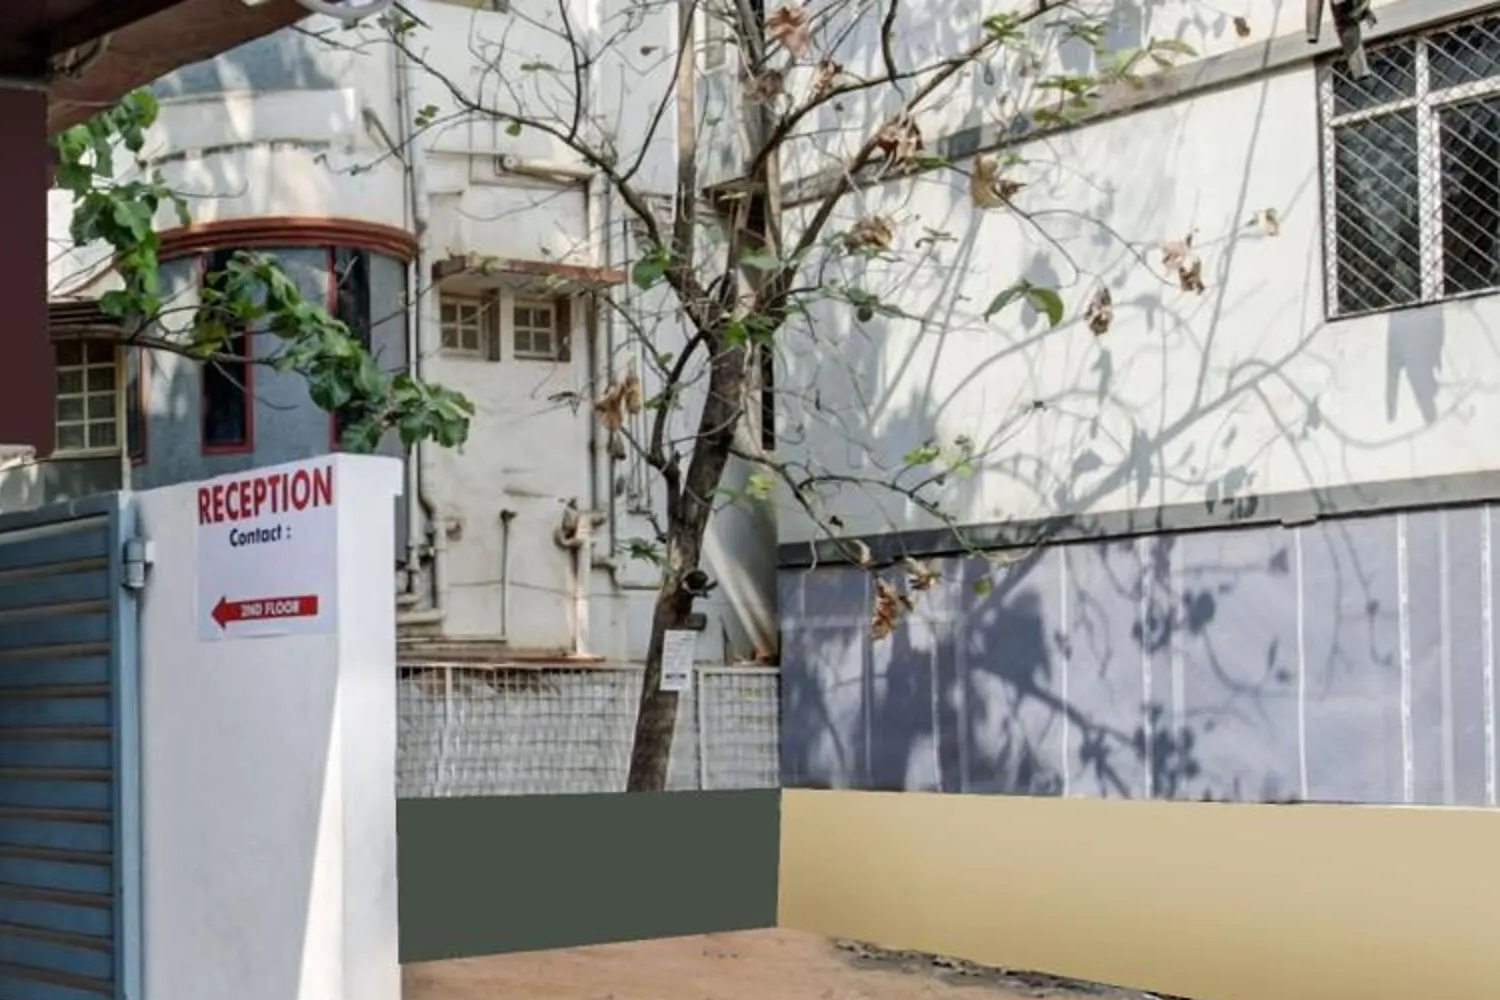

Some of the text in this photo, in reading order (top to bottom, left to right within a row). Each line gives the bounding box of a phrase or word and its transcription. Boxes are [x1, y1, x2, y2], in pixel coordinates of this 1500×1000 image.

[198, 466, 332, 524] RECEPTION
[229, 525, 282, 547] Contact
[241, 600, 299, 618] 2ND FLOOR
